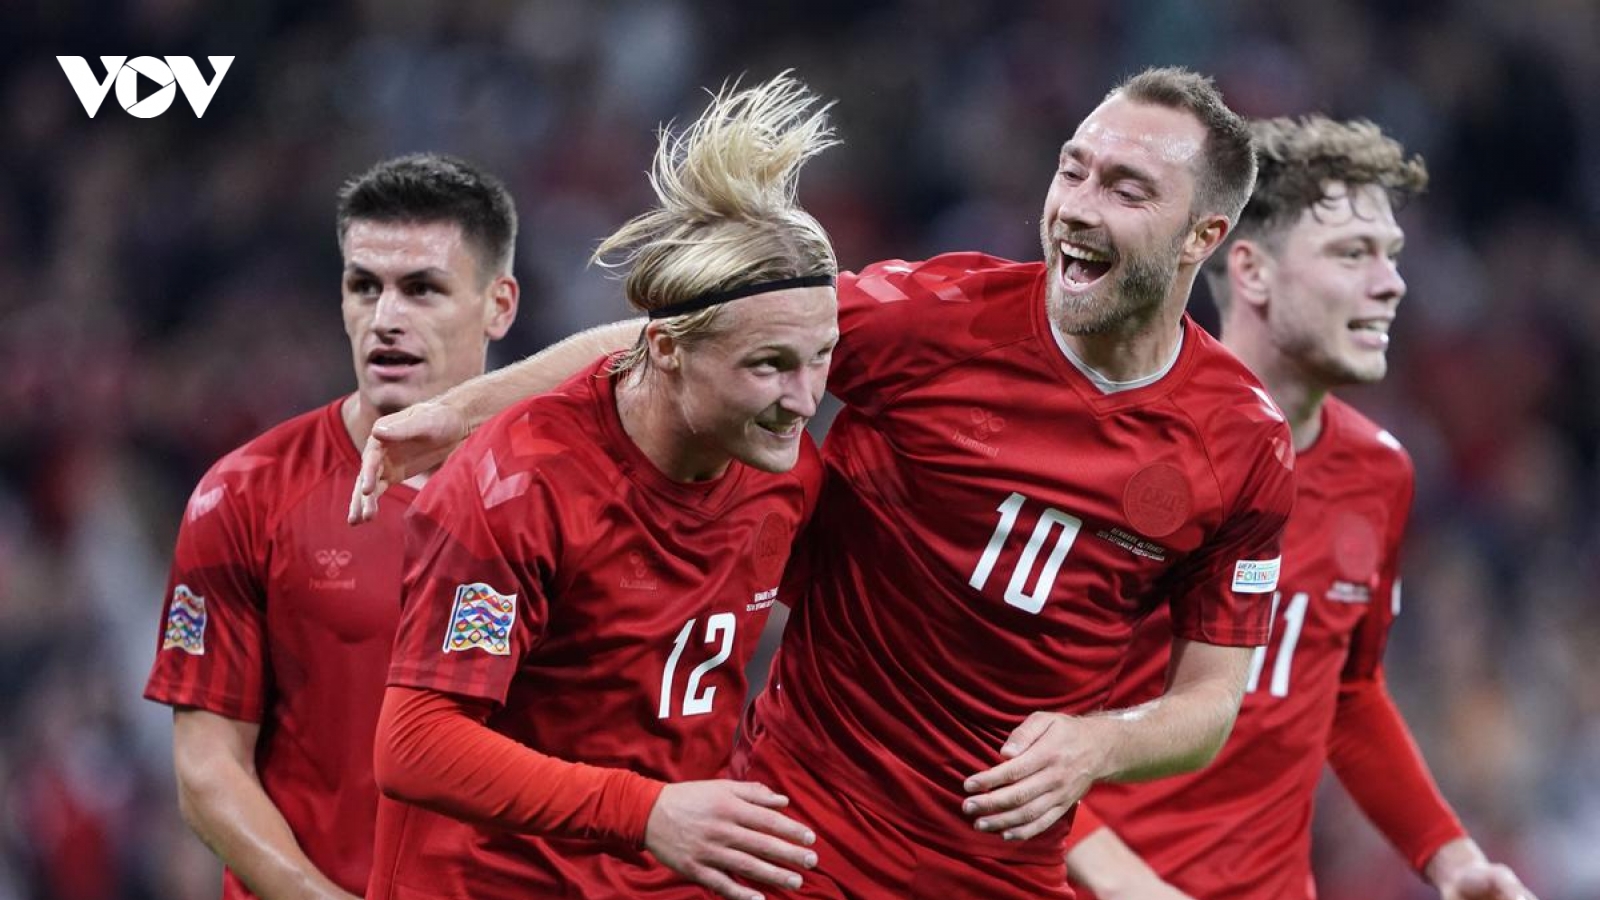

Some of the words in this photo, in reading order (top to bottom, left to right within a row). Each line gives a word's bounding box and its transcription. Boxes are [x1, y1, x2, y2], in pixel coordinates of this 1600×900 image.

[952, 429, 1000, 458] hummel
[969, 491, 1082, 614] 10
[658, 613, 736, 719] 12
